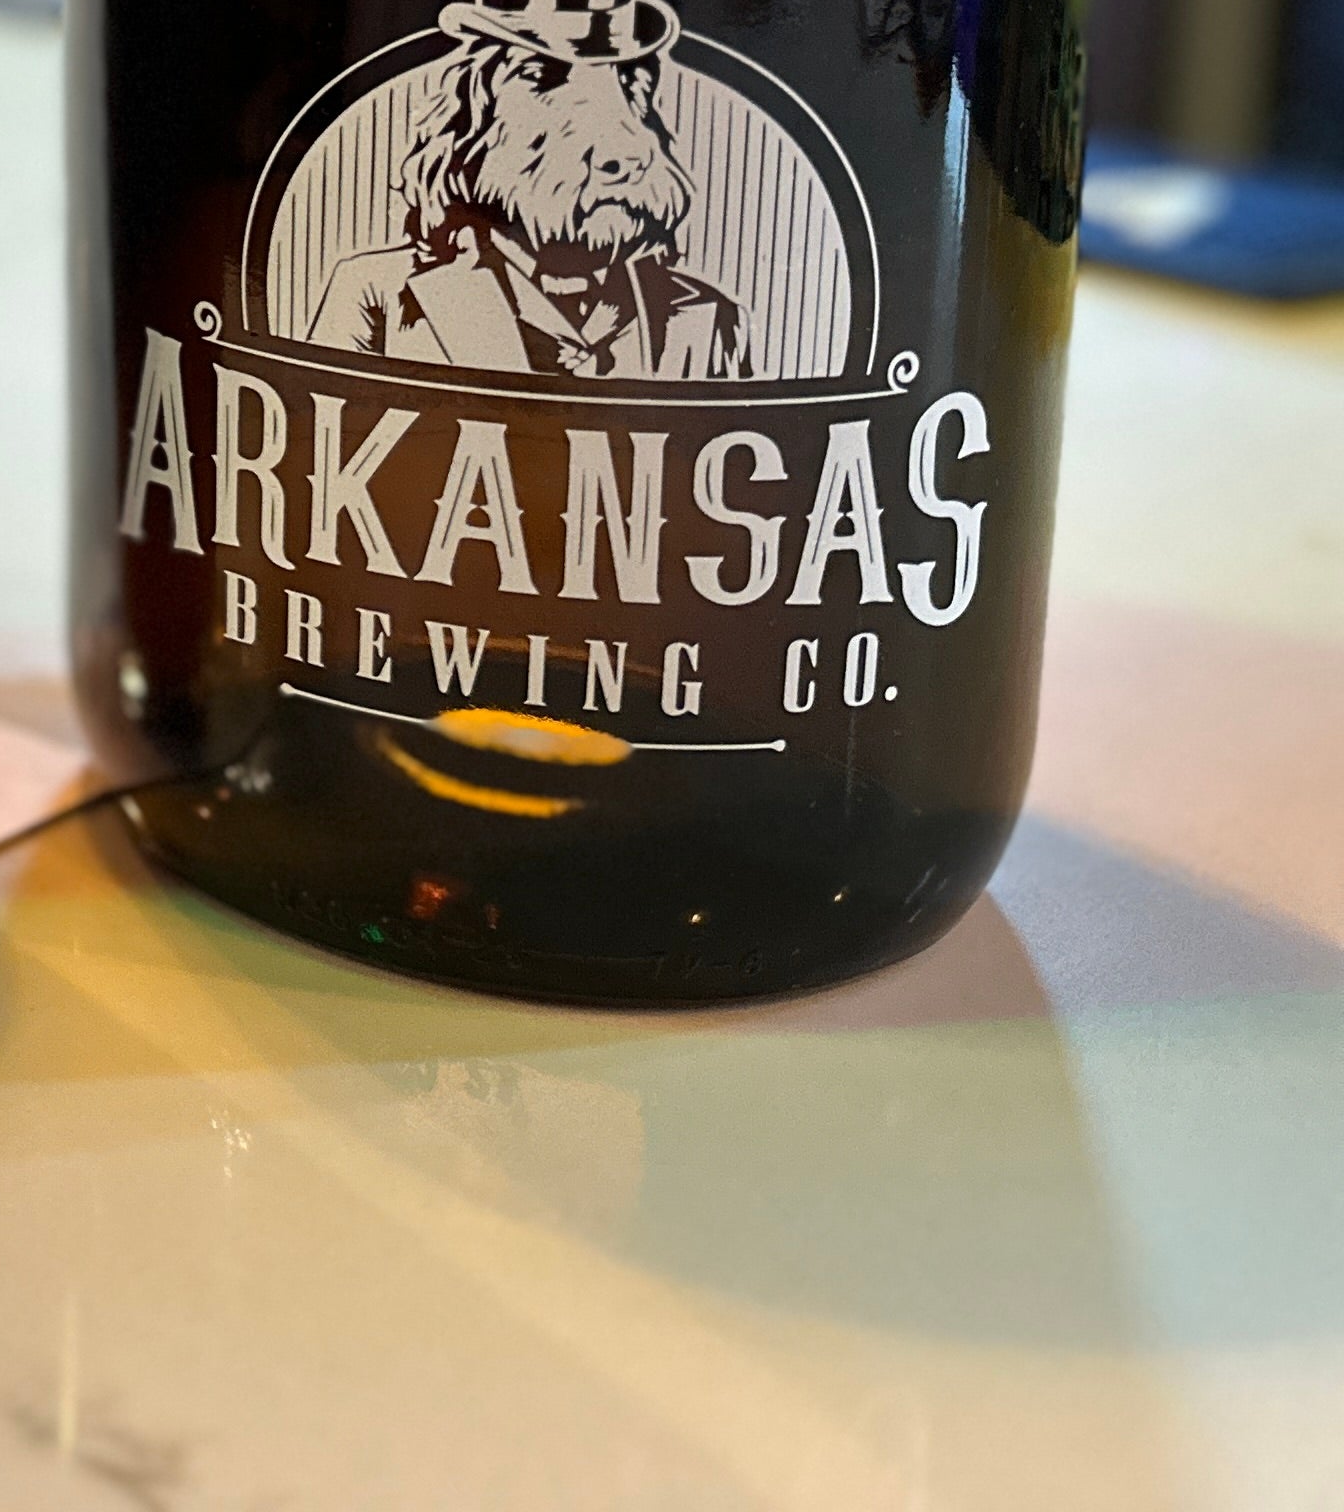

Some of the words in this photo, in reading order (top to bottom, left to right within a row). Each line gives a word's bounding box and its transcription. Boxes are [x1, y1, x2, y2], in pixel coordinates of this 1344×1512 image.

[119, 325, 990, 627] ARKANSAS
[222, 568, 703, 717] BREWING
[783, 631, 899, 714] CO.
